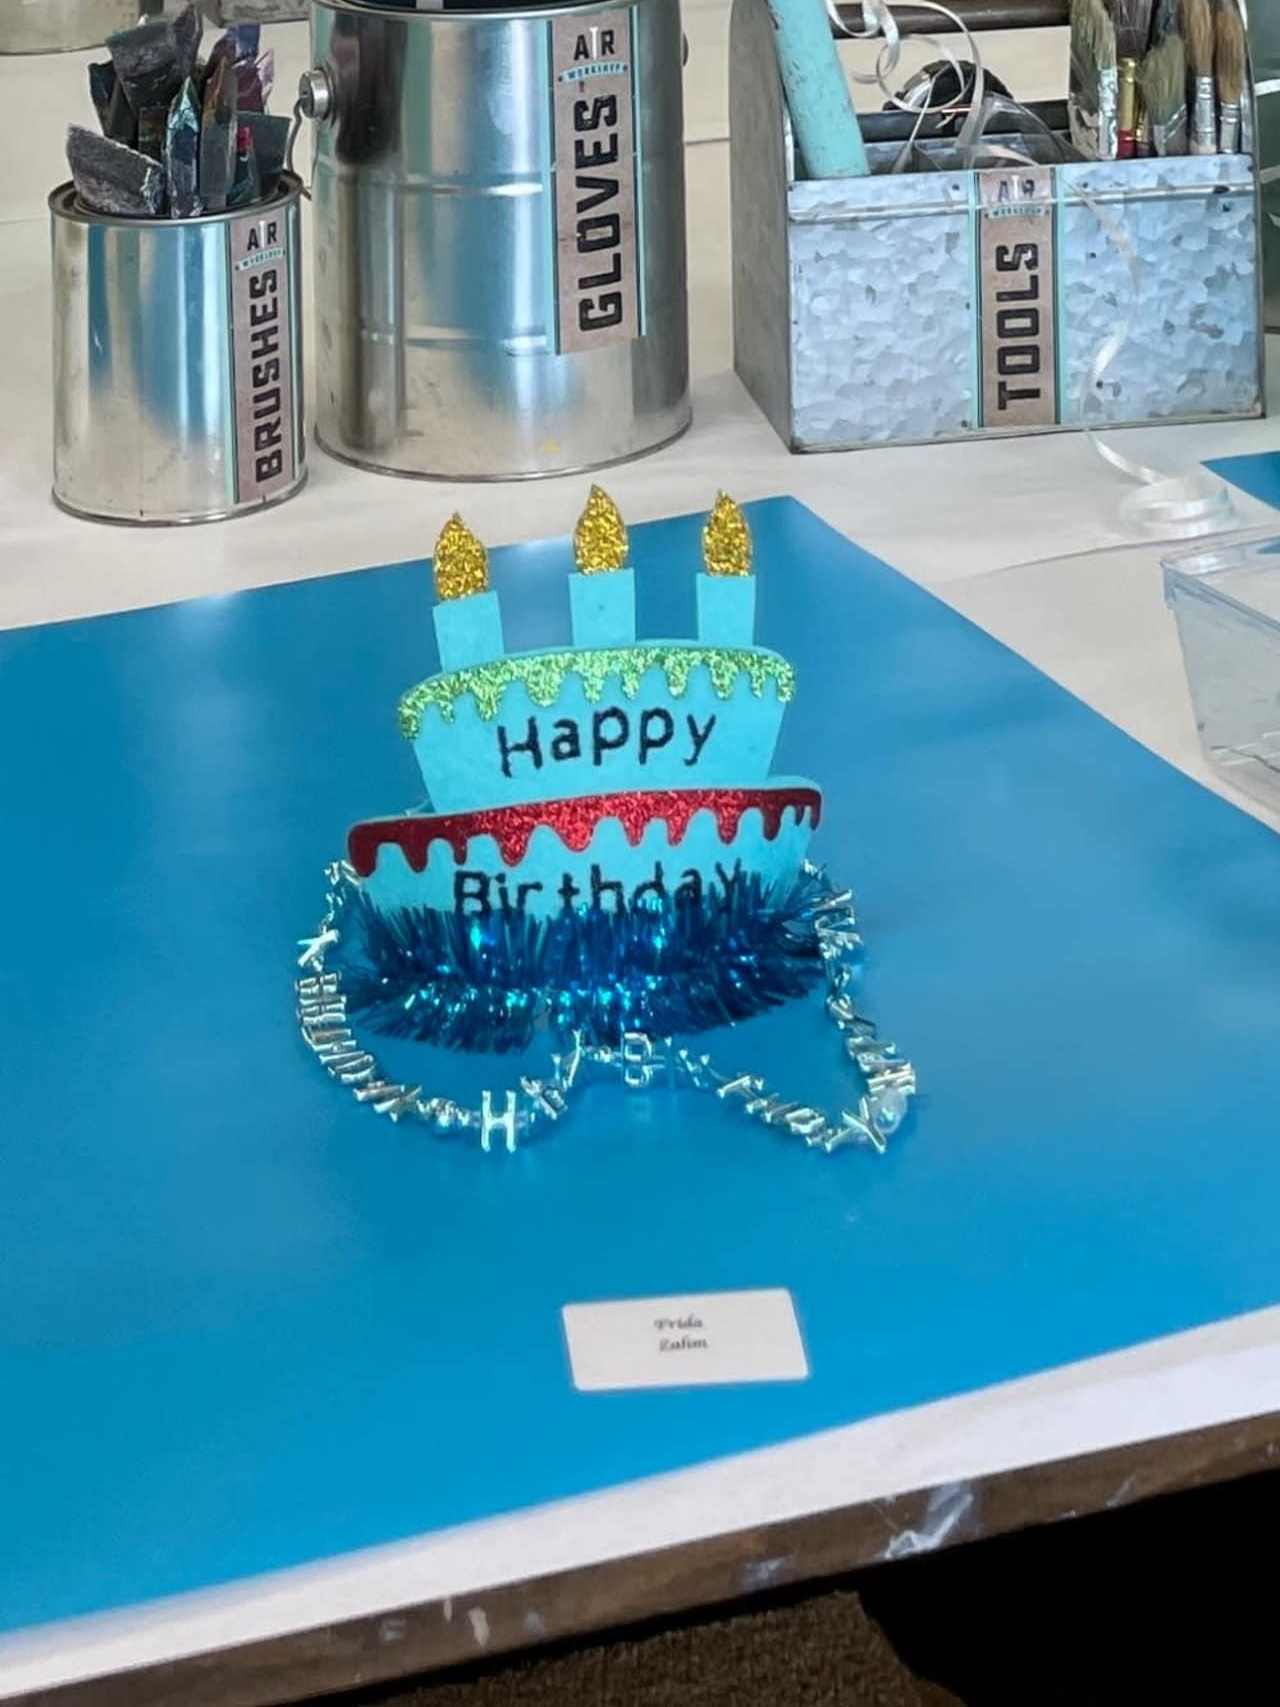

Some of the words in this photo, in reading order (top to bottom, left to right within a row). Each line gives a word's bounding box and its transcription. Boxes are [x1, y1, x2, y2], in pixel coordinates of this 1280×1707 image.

[573, 26, 616, 61] AIR
[246, 220, 278, 251] AIR
[574, 93, 622, 333] GLOVES
[995, 242, 1041, 411] TOOLS
[249, 268, 283, 483] BRUSHES
[496, 706, 716, 777] Happy
[453, 856, 742, 918] Birthday
